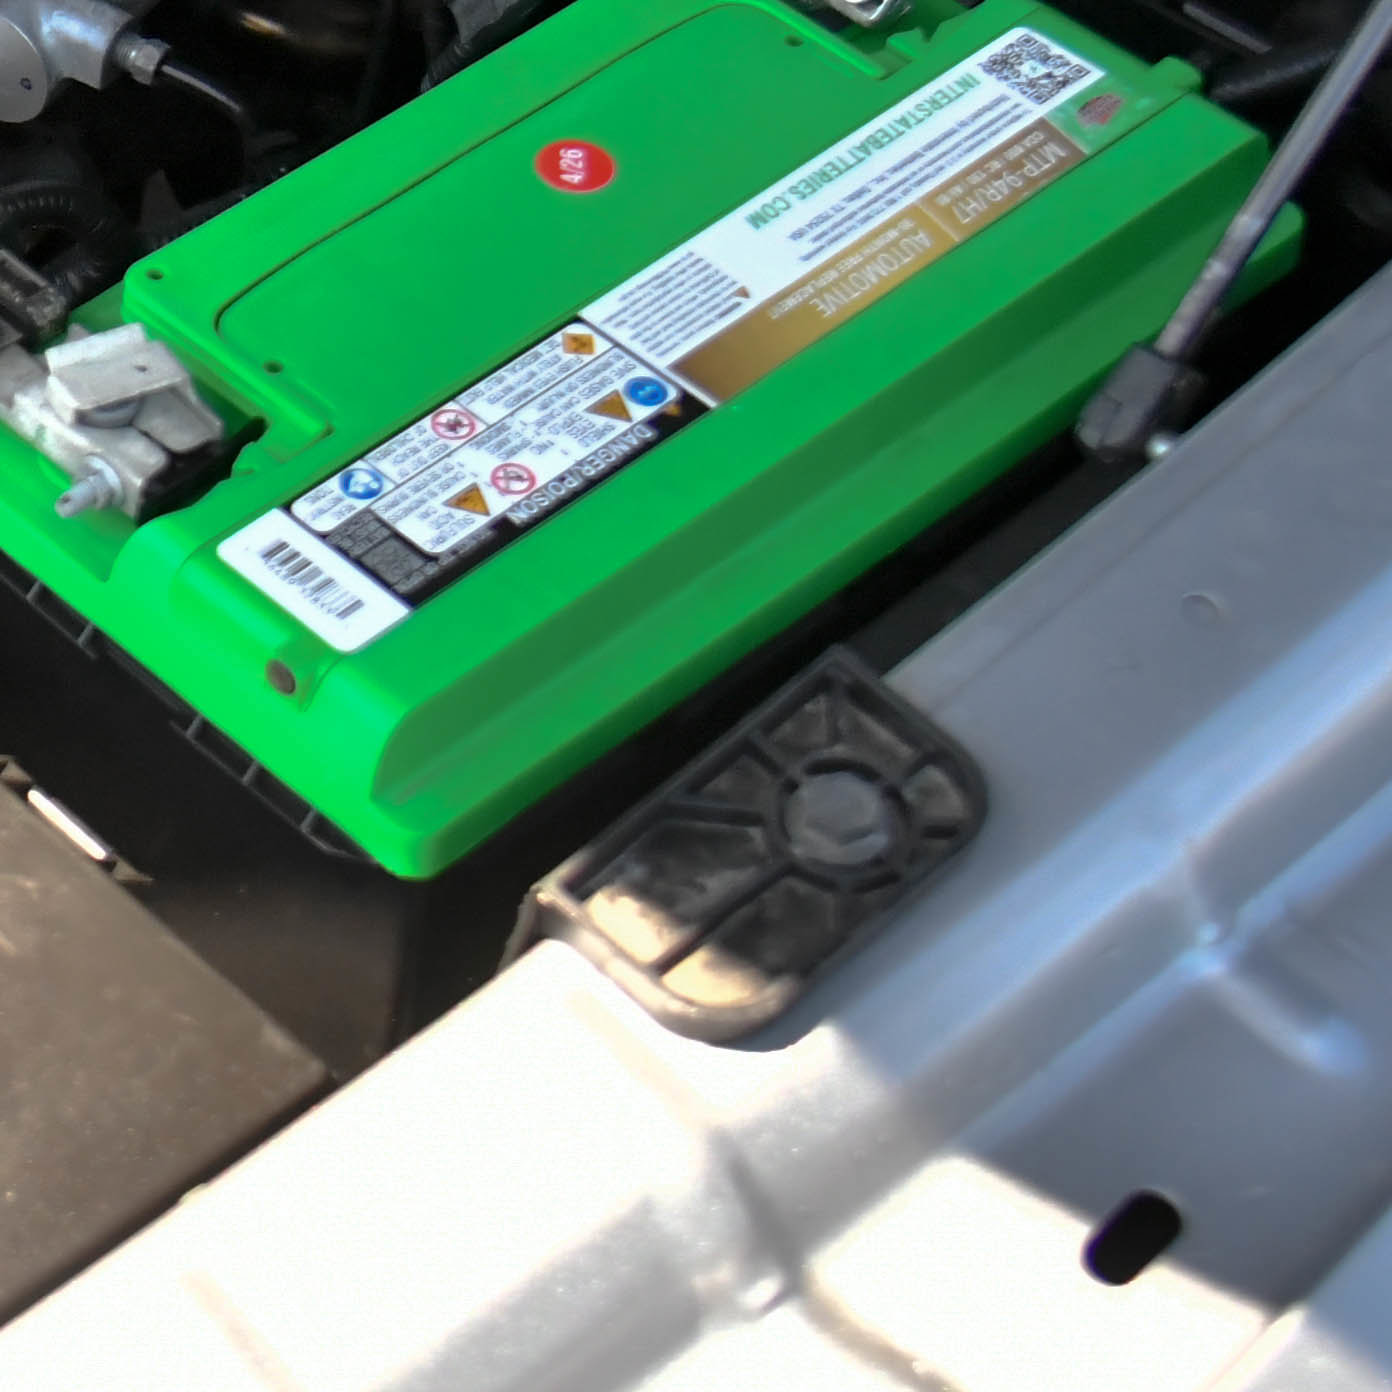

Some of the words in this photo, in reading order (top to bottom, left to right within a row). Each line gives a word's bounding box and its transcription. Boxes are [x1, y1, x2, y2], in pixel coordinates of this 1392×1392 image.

[741, 71, 982, 231] INTERSTATEBATTERIES.COM
[954, 141, 1067, 224] MTP-94R/H7
[805, 227, 936, 320] AUTOMOTIVE
[501, 422, 656, 526] DANGER/POISON
